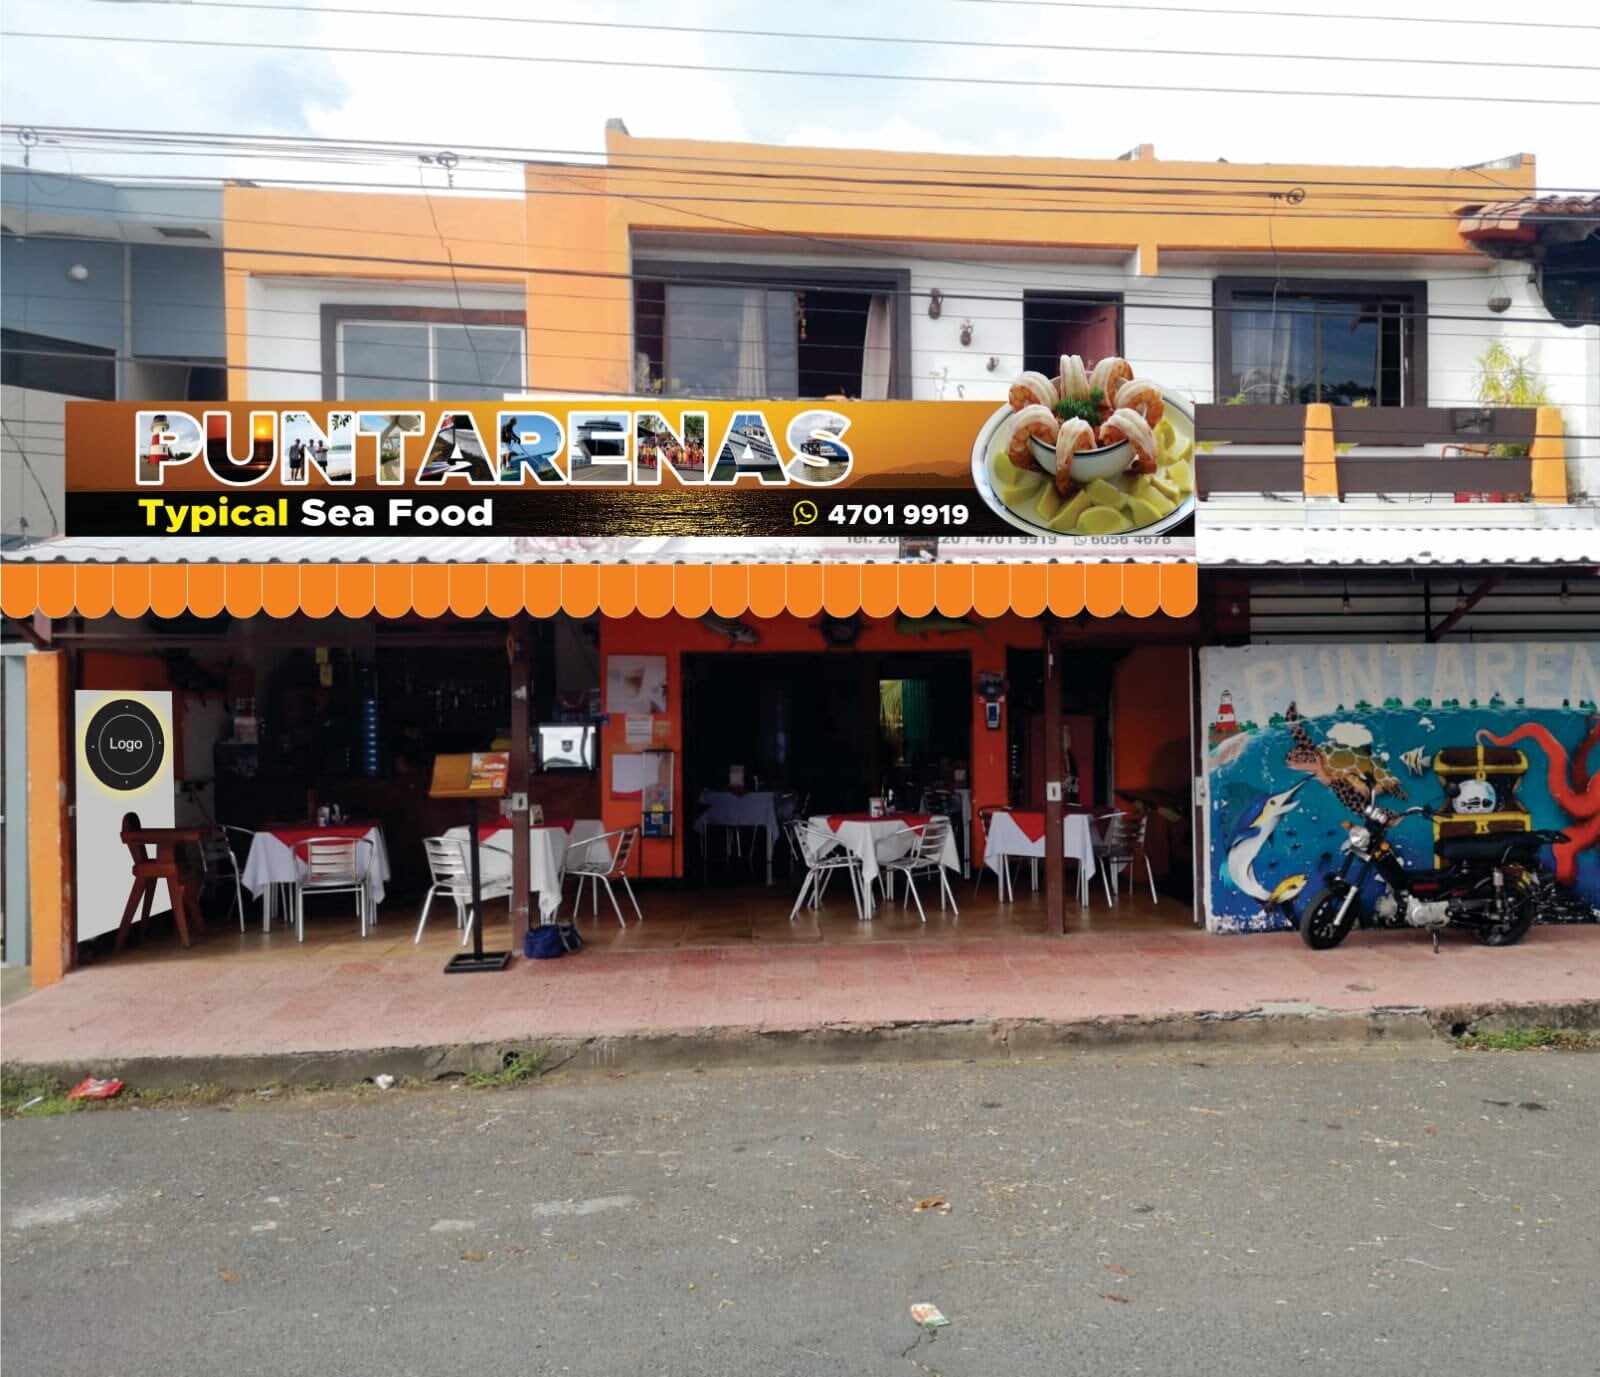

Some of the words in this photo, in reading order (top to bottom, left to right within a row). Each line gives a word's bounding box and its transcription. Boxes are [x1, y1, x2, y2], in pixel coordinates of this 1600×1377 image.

[135, 410, 853, 487] PUNTARENAS
[138, 496, 288, 533] Typical
[301, 498, 375, 527] Sea
[389, 498, 493, 527] Food
[828, 504, 895, 525] 4701
[903, 504, 970, 525] 9919
[109, 736, 143, 753] Logo
